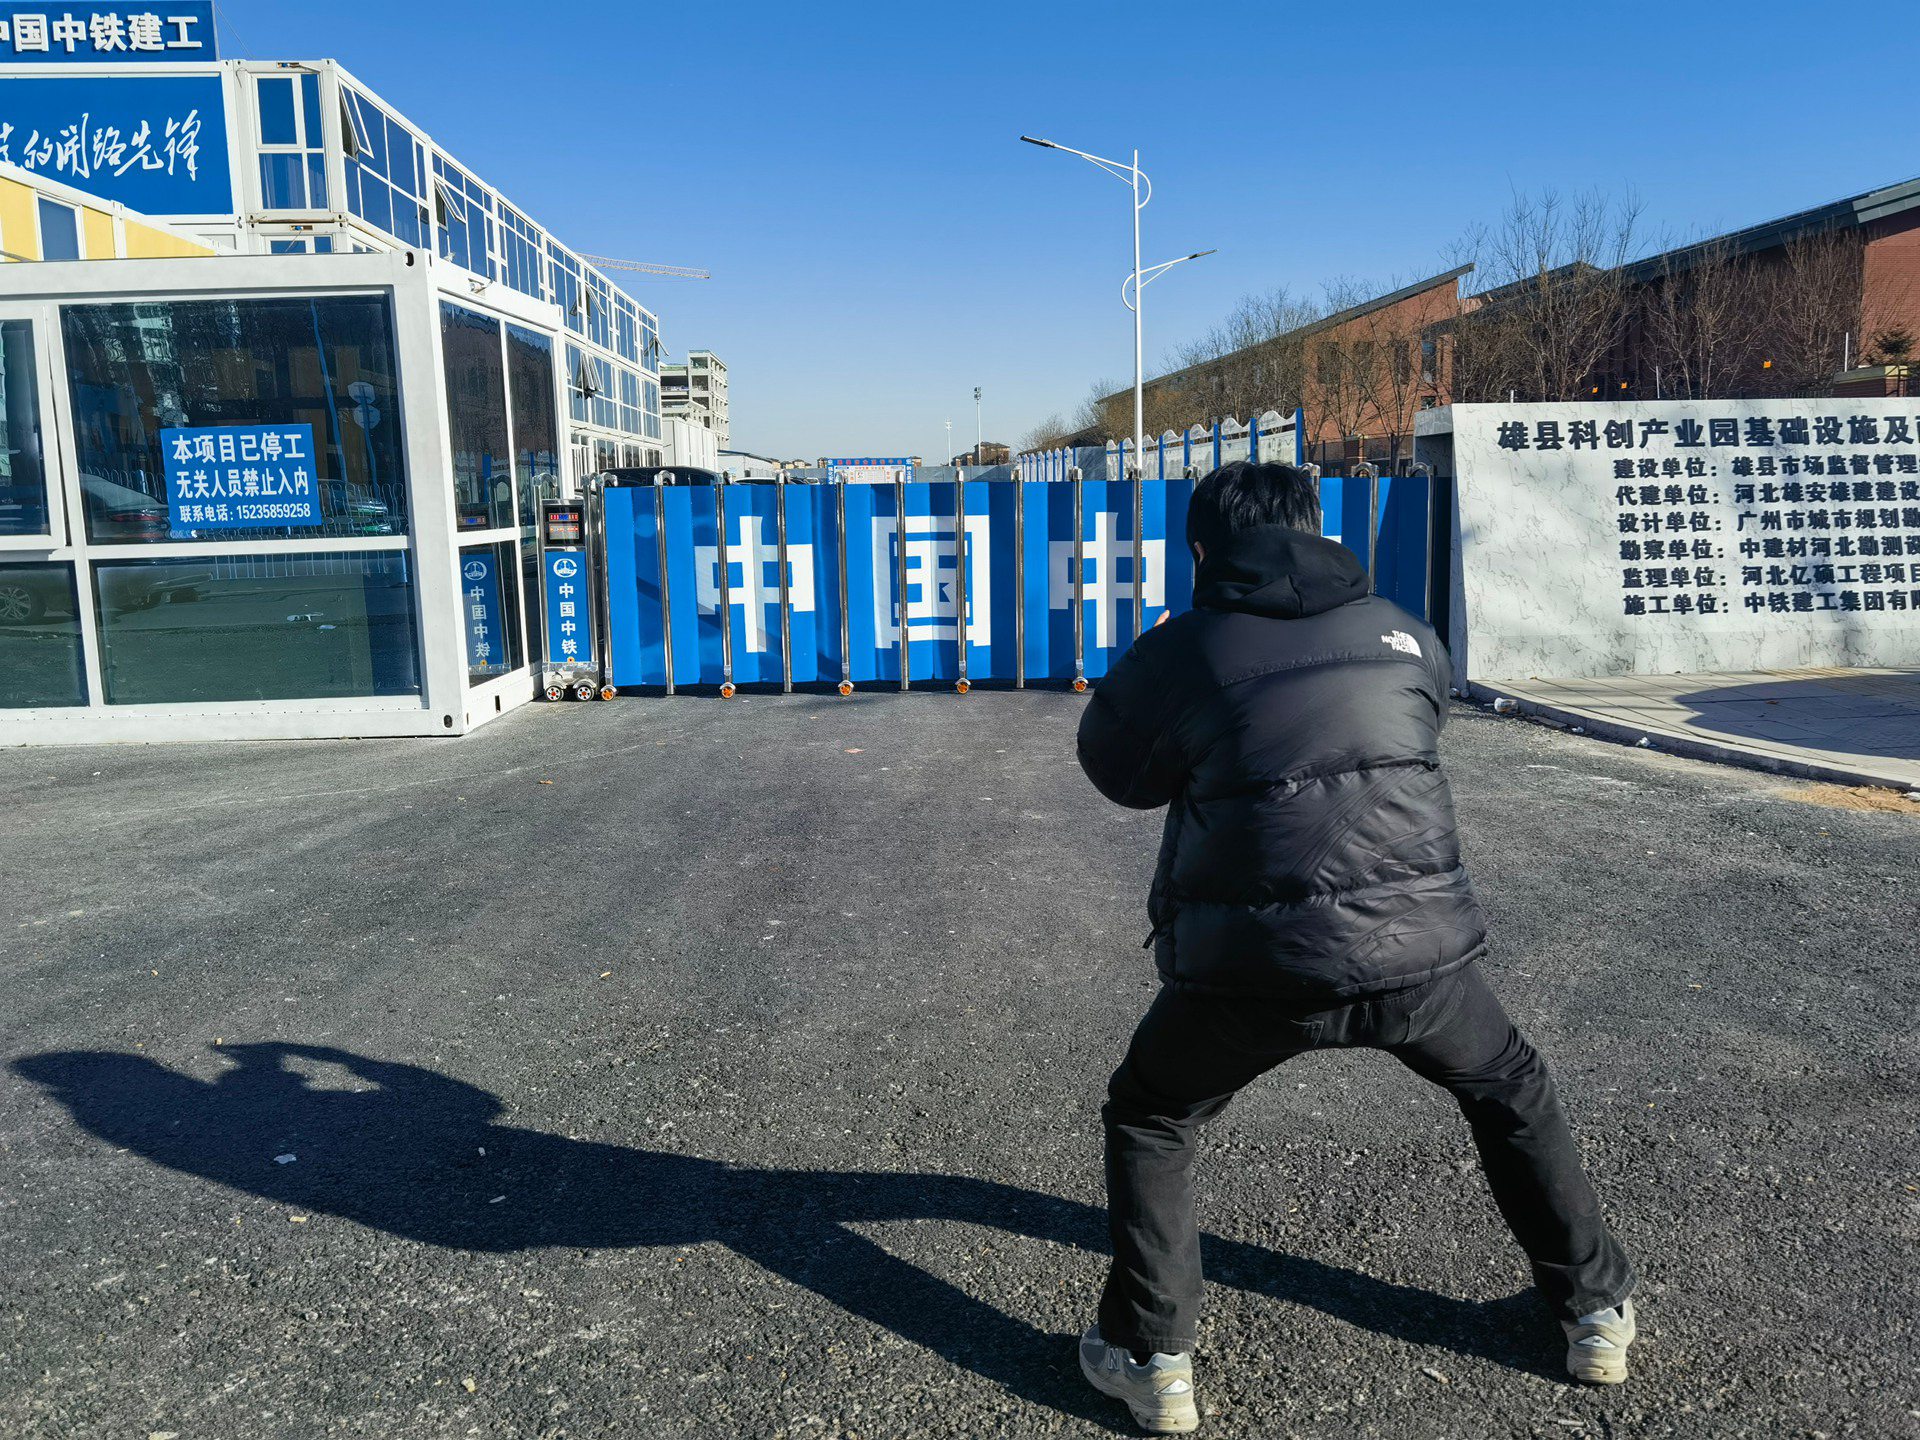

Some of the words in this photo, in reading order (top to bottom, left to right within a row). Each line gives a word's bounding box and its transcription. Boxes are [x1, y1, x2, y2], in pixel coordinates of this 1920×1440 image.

[172, 432, 305, 464] 本项目已停工
[1497, 415, 1920, 451] 雄县科创产业园基础设施及
[176, 466, 309, 499] 无关人员禁止入内
[694, 511, 1342, 654] 中国中
[559, 583, 578, 655] 中国中铁
